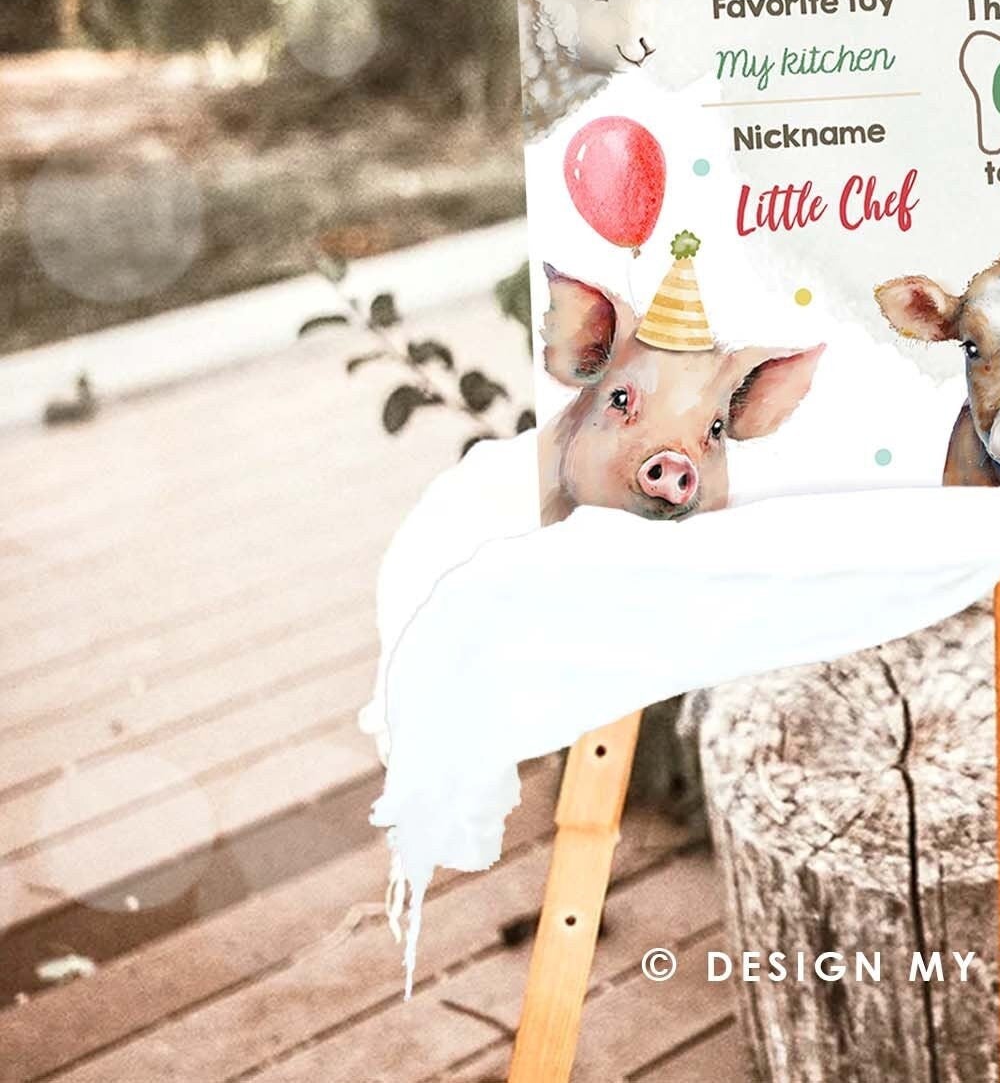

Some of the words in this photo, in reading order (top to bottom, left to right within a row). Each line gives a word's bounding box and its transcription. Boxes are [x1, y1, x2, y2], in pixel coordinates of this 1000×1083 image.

[716, 48, 776, 92] My
[780, 44, 896, 77] kitchen
[733, 123, 886, 152] Nickname
[736, 180, 829, 237] Little
[838, 168, 921, 233] Chef
